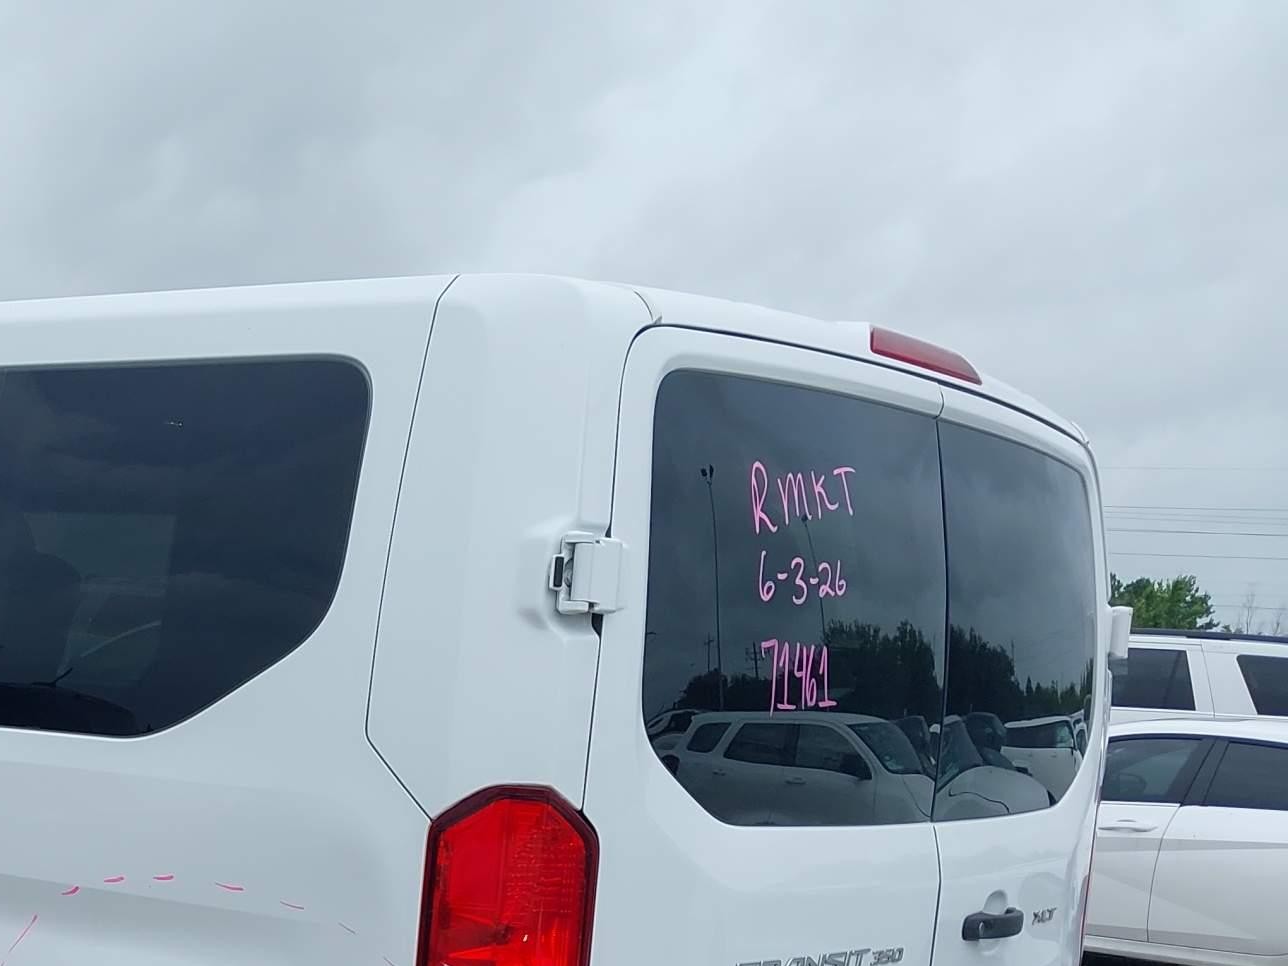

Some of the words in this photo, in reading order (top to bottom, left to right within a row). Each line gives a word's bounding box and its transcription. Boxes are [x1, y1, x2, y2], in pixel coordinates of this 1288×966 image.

[751, 461, 856, 535] RMKT
[759, 550, 847, 605] 6-3-26
[761, 639, 838, 718] 71461
[1031, 907, 1057, 926] XLT
[869, 947, 905, 966] 350
